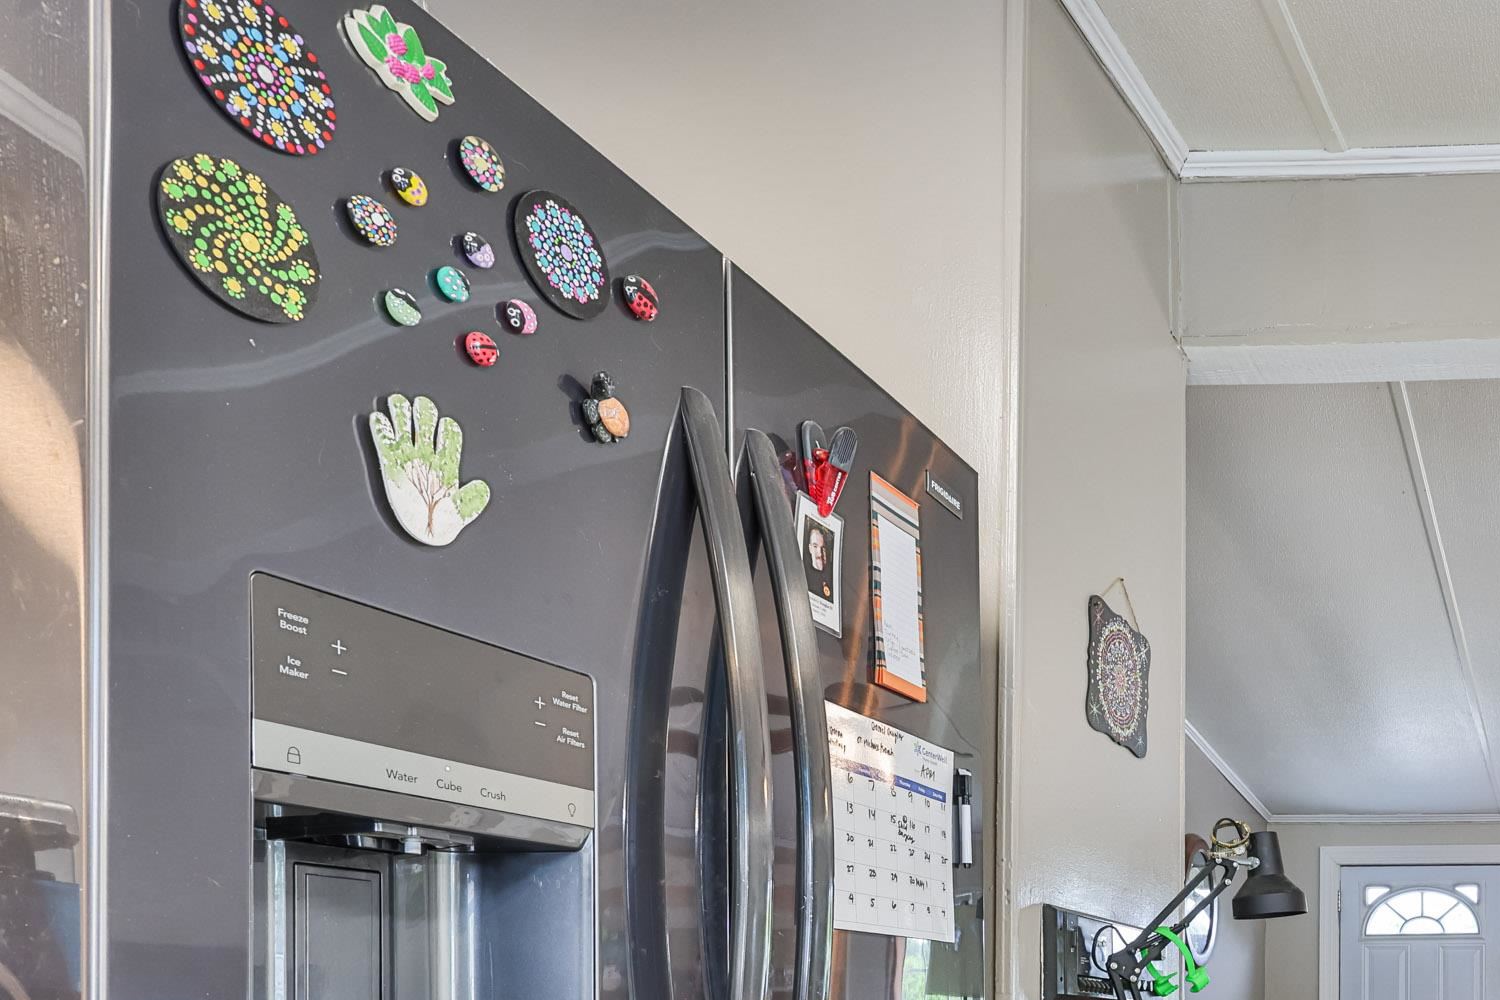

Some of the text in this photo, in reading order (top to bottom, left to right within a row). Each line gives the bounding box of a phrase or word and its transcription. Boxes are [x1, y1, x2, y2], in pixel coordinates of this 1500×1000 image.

[931, 480, 960, 510] FRIGIDAIRE
[277, 607, 309, 625] Freeze
[280, 619, 308, 635] Boost
[287, 655, 302, 666] Ice
[280, 664, 309, 680] Maker
[562, 690, 578, 702] Reset
[552, 696, 588, 713] Water Filter
[562, 727, 580, 738] Reset
[556, 735, 585, 748] Air Filters
[386, 768, 506, 801] Water Cube Crush
[868, 780, 875, 791] 7
[908, 791, 913, 803] 9
[924, 798, 930, 808] 10
[846, 801, 854, 814] 13
[868, 808, 876, 820] 14
[890, 814, 896, 824] 15
[924, 825, 930, 834] 17
[848, 893, 854, 904] 4
[870, 898, 875, 908] 5
